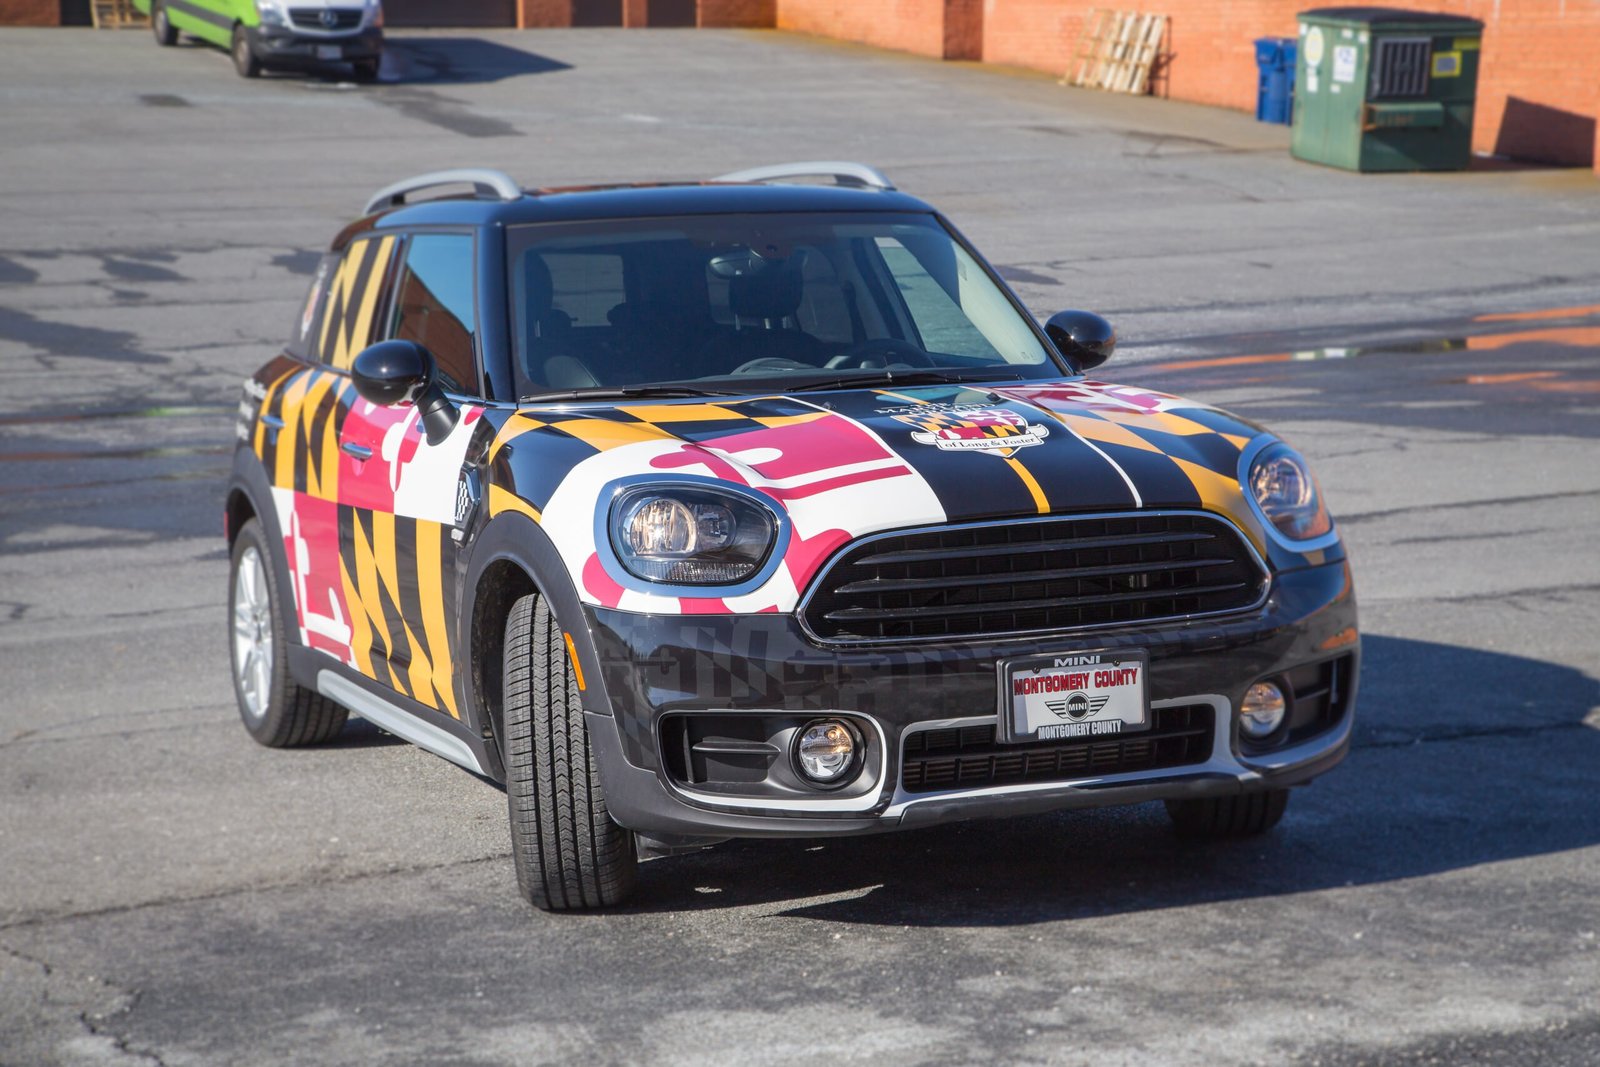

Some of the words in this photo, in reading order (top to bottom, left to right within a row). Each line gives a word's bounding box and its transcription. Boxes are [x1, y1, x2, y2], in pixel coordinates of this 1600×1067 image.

[960, 441, 989, 449] Long
[1003, 438, 1035, 446] Foster
[1054, 655, 1101, 668] MINI
[1014, 673, 1090, 696] MONTGOMERY
[1094, 668, 1138, 689] COUNTY
[1068, 703, 1088, 712] MINI
[1038, 723, 1091, 740] MONTGOMERY
[1091, 720, 1122, 735] COUNTY
